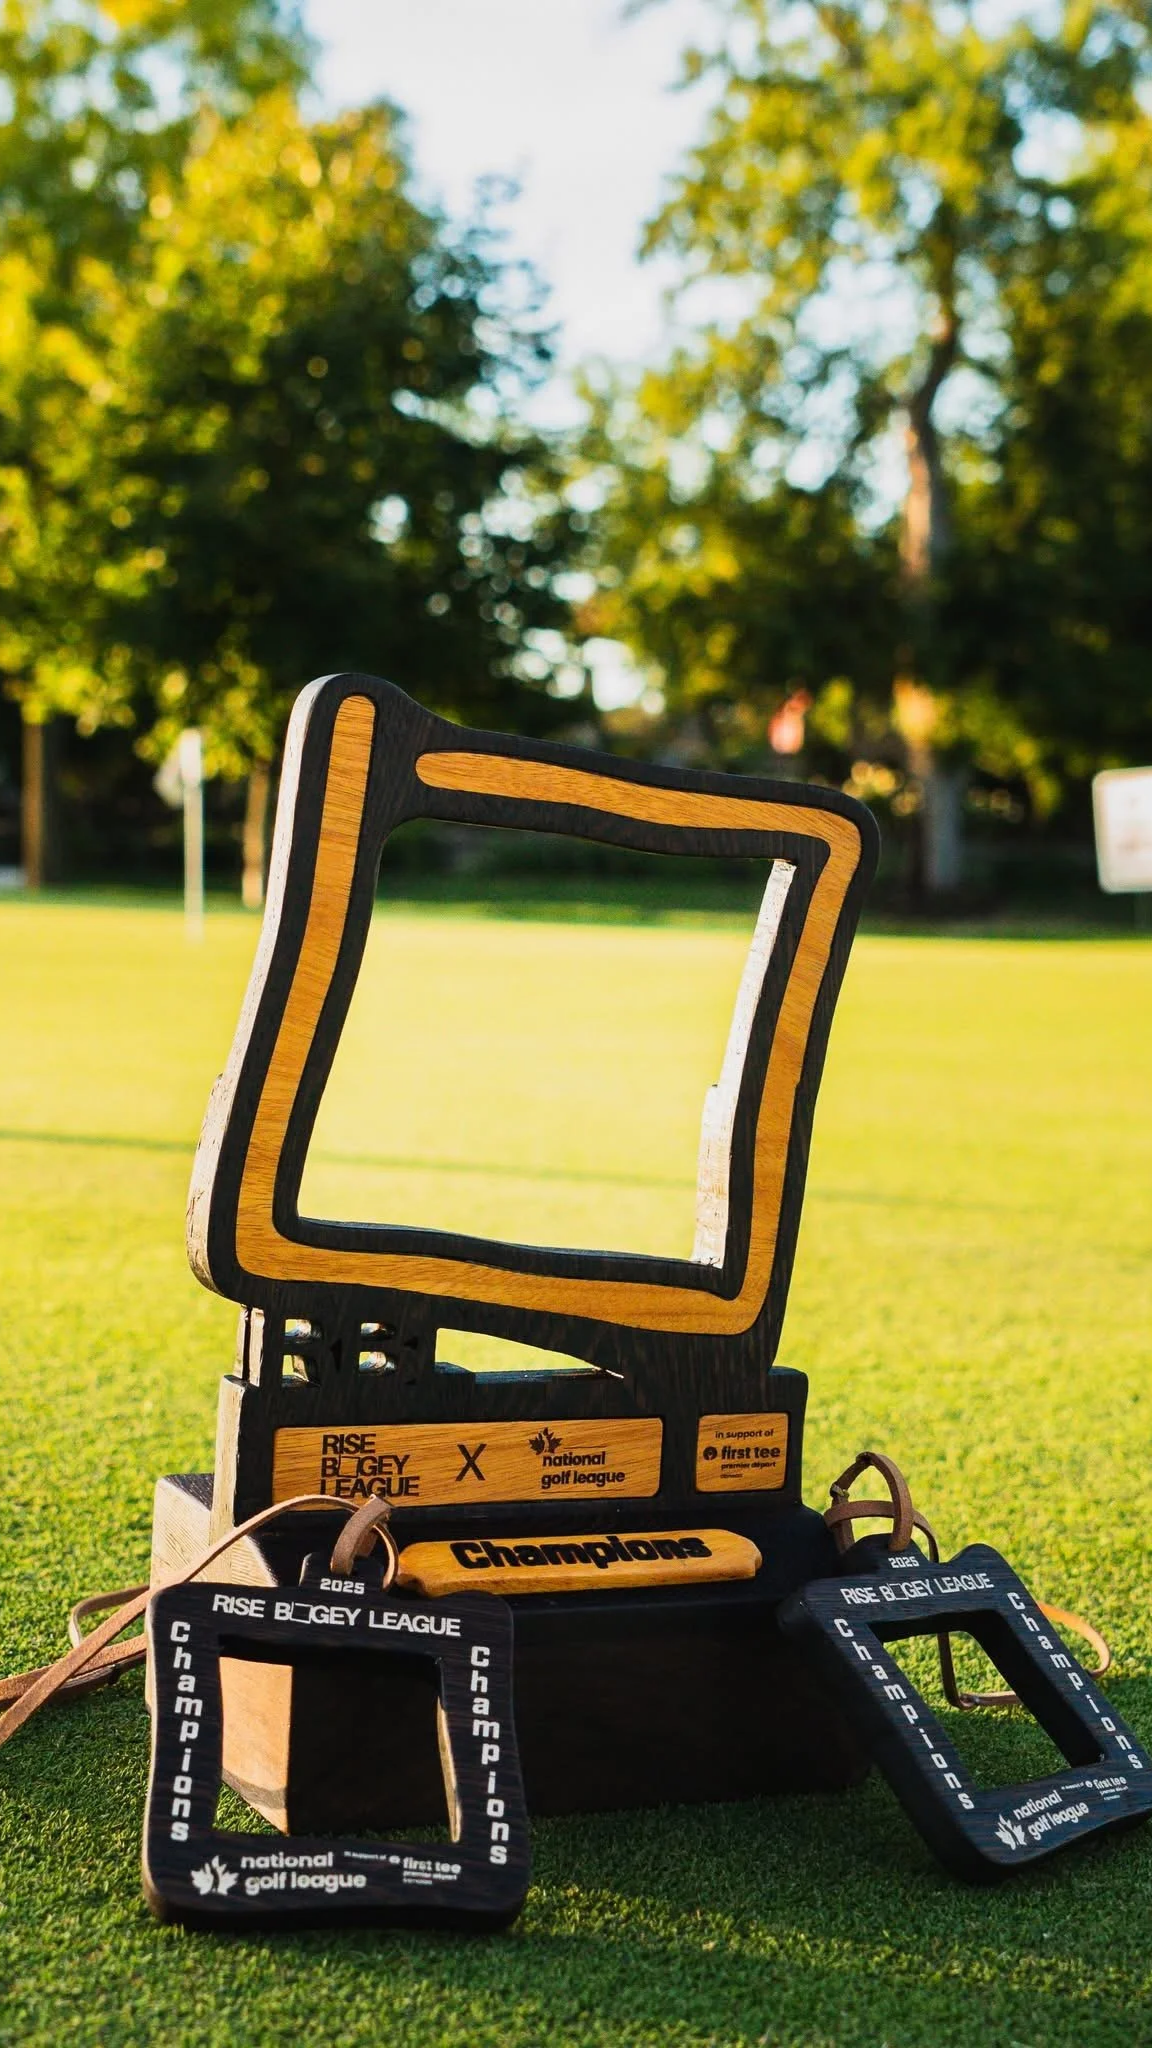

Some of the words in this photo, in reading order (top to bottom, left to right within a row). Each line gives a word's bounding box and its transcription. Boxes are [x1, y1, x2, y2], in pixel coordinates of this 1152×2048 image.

[322, 1433, 377, 1455] RISE
[715, 1430, 724, 1438] in
[725, 1429, 762, 1440] support
[764, 1428, 774, 1437] of
[455, 1443, 487, 1482] X
[542, 1451, 606, 1467] national
[721, 1445, 751, 1460] first
[754, 1446, 781, 1458] tee
[721, 1462, 750, 1471] premier
[320, 1476, 420, 1498] LEAGUE
[541, 1471, 571, 1489] golf
[573, 1469, 625, 1487] league
[449, 1535, 713, 1569] Champions
[888, 1556, 920, 1569] 2025
[320, 1577, 365, 1595] 2025
[840, 1586, 880, 1605] RISE
[934, 1573, 994, 1594] LEAGUE
[212, 1593, 266, 1619] RISE
[369, 1610, 462, 1637] LEAGUE
[1007, 1592, 1143, 1769] Champions
[834, 1618, 975, 1810] Champions
[170, 1621, 203, 1842] Champions
[470, 1645, 510, 1865] Champions
[1093, 1778, 1112, 1790] first
[1111, 1776, 1127, 1786] tee
[1013, 1789, 1063, 1820] national
[1028, 1812, 1052, 1841] golf
[1049, 1801, 1090, 1827] league
[240, 1851, 334, 1869] national
[403, 1857, 433, 1871] first
[435, 1860, 462, 1874] tee
[245, 1871, 287, 1896] golf
[291, 1871, 367, 1894] league
